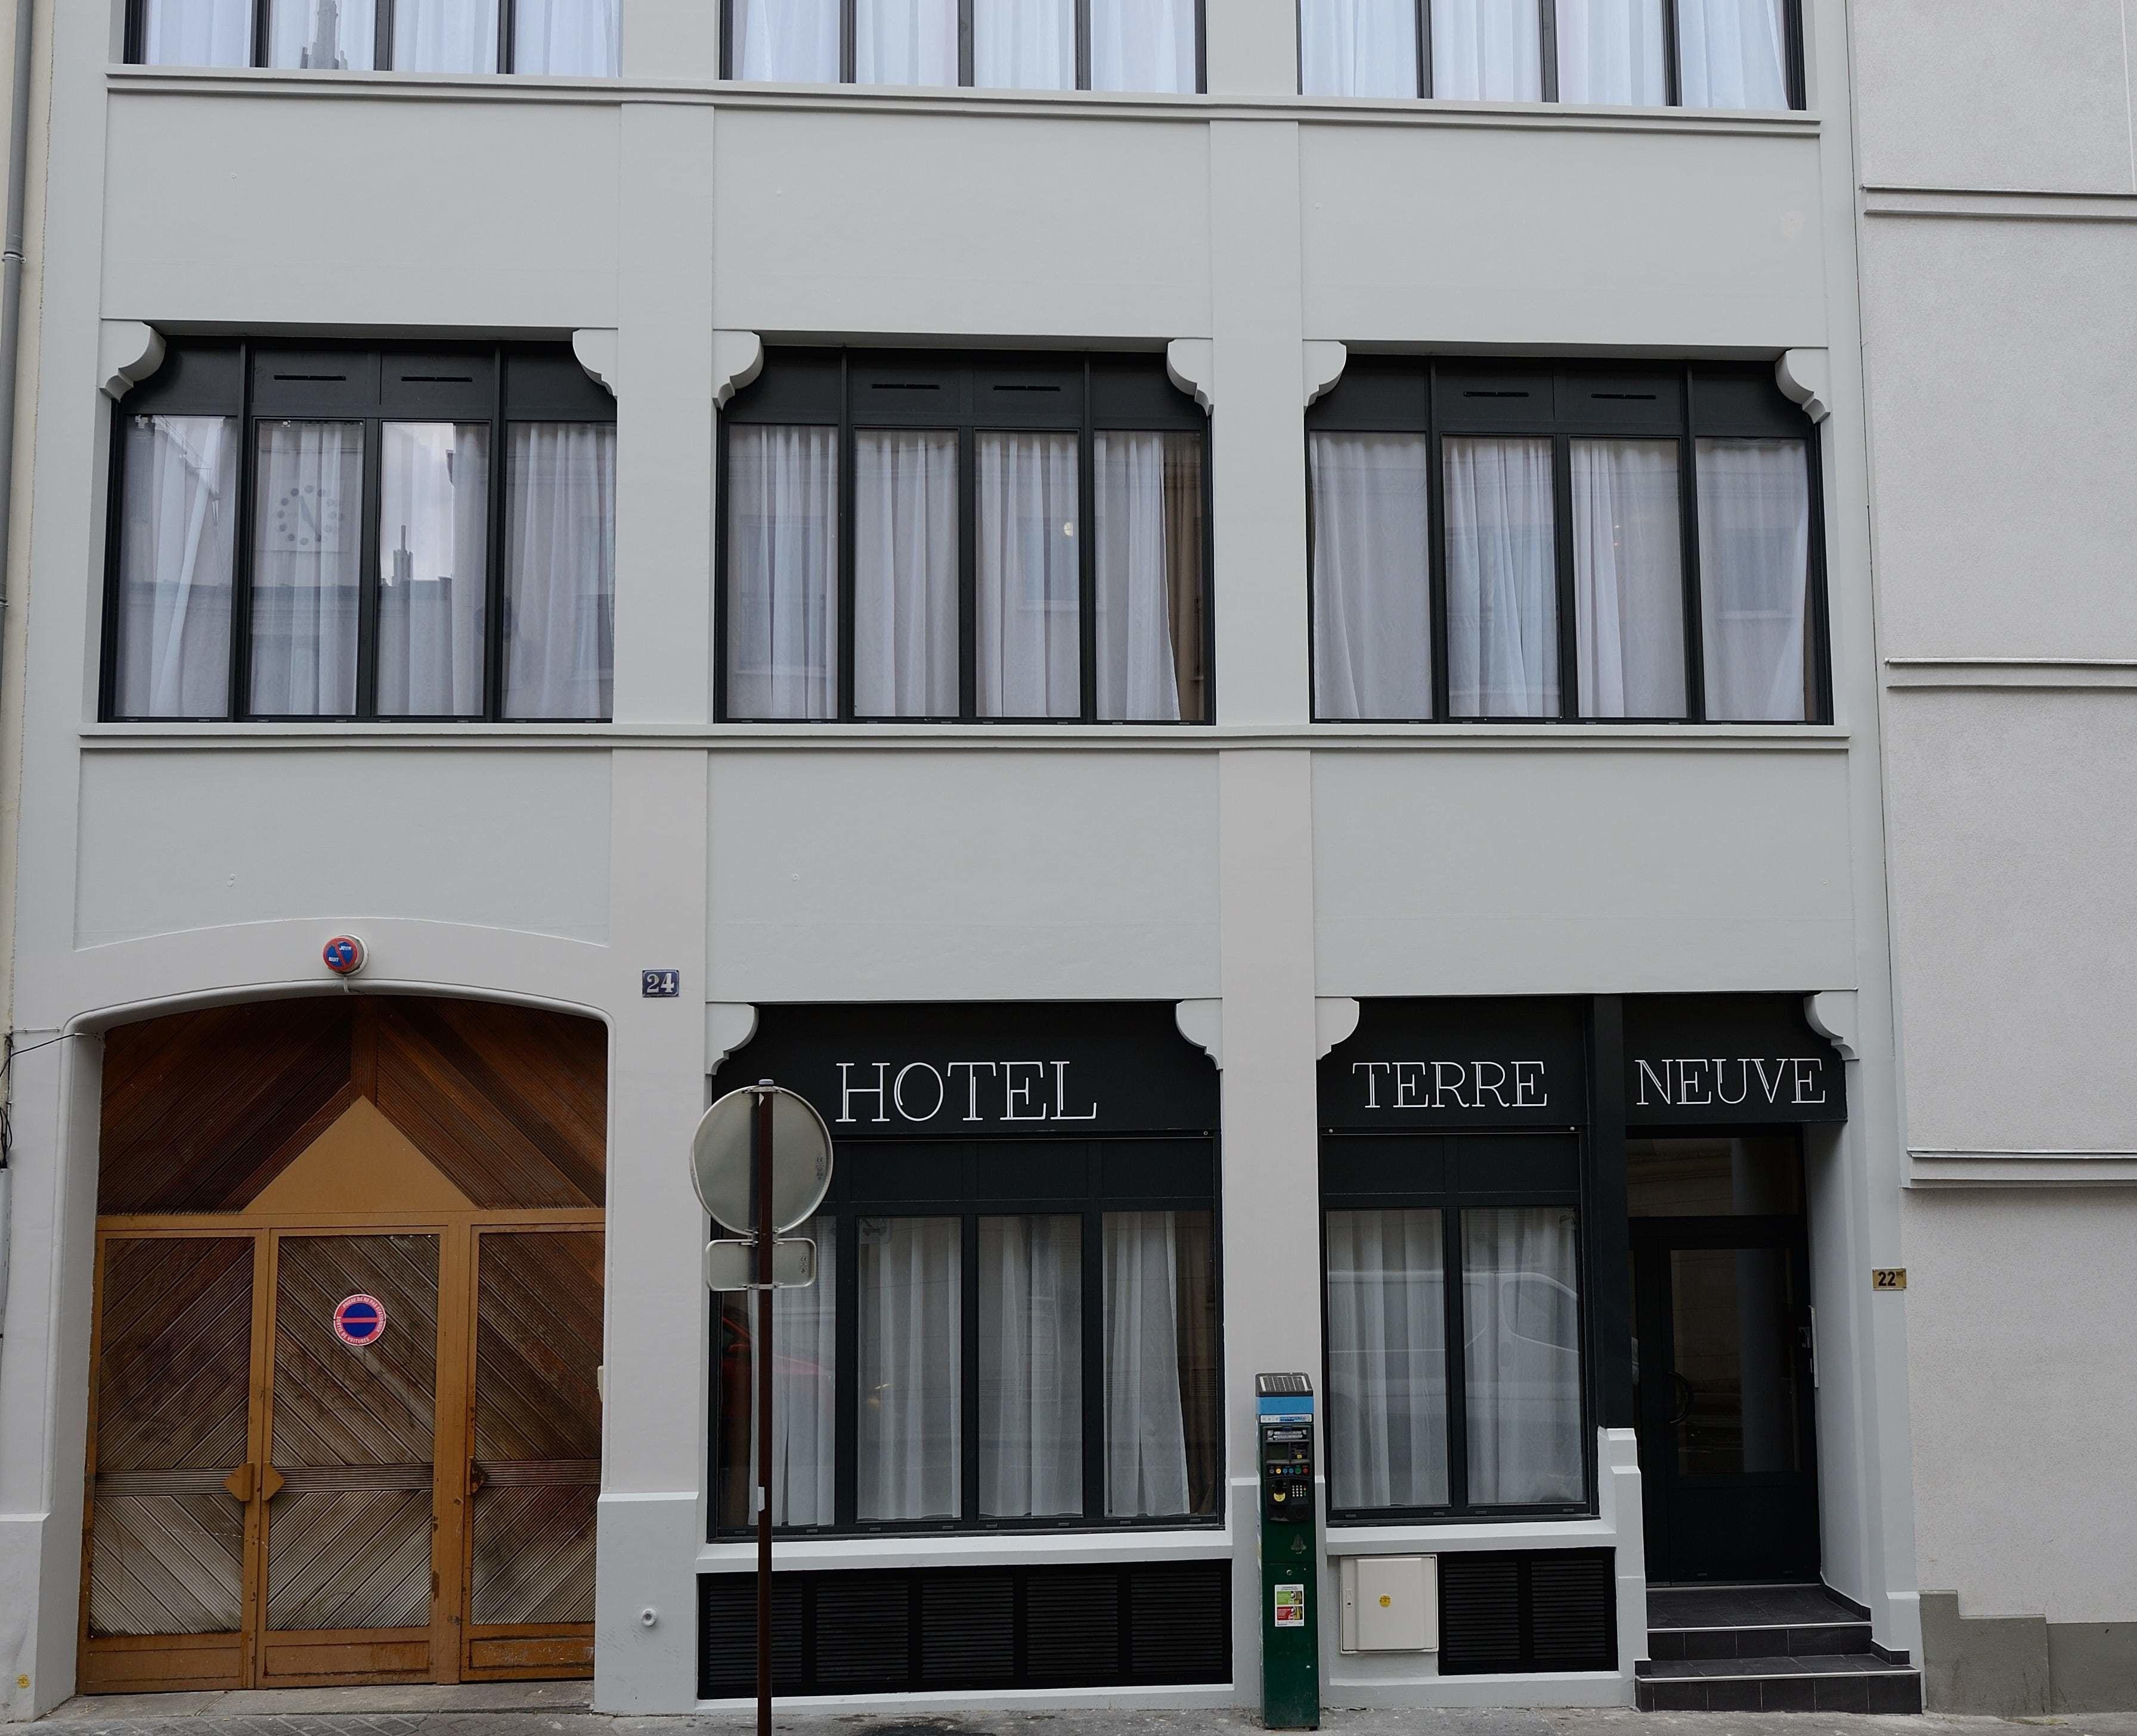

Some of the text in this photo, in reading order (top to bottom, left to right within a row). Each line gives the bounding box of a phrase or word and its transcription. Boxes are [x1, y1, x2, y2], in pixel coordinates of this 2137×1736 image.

[647, 973, 675, 993] 24
[835, 1061, 1097, 1122] HOTEL
[1352, 1058, 1826, 1109] TERRE NEUVE
[1878, 1271, 1896, 1286] 22
[369, 1299, 378, 1308] PAS
